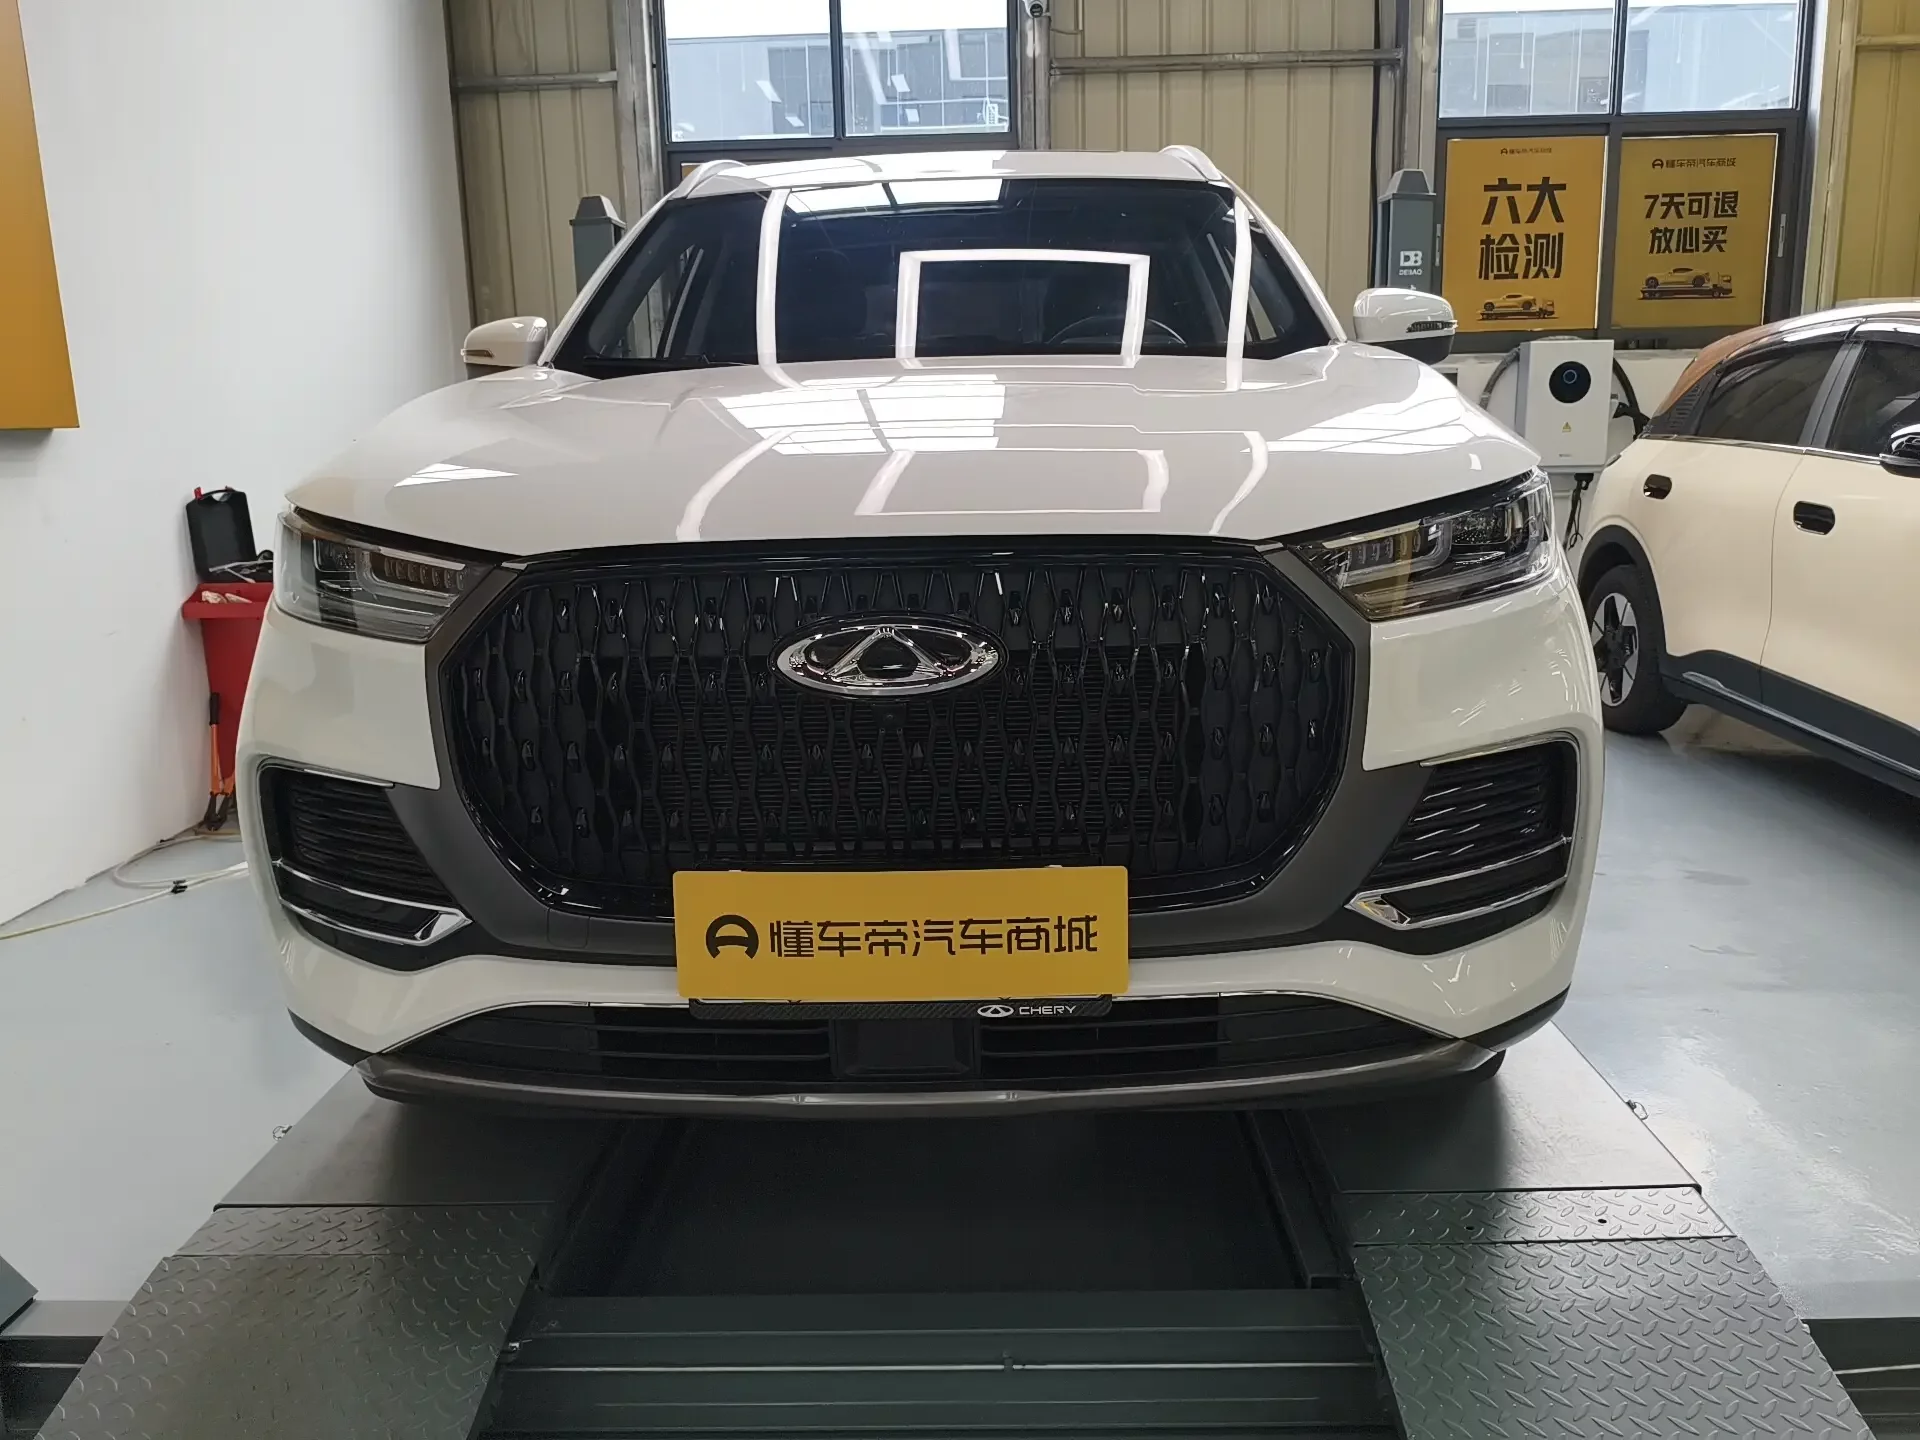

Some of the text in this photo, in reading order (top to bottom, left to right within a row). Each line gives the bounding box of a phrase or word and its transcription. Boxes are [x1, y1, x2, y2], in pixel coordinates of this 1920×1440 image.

[1481, 176, 1567, 225] 六大
[1643, 190, 1740, 220] 7天可退
[1478, 231, 1564, 281] 检测
[1648, 225, 1728, 255] 放心买
[769, 914, 1099, 958] 懂车帝汽车商城
[1018, 1005, 1077, 1015] CHERY
